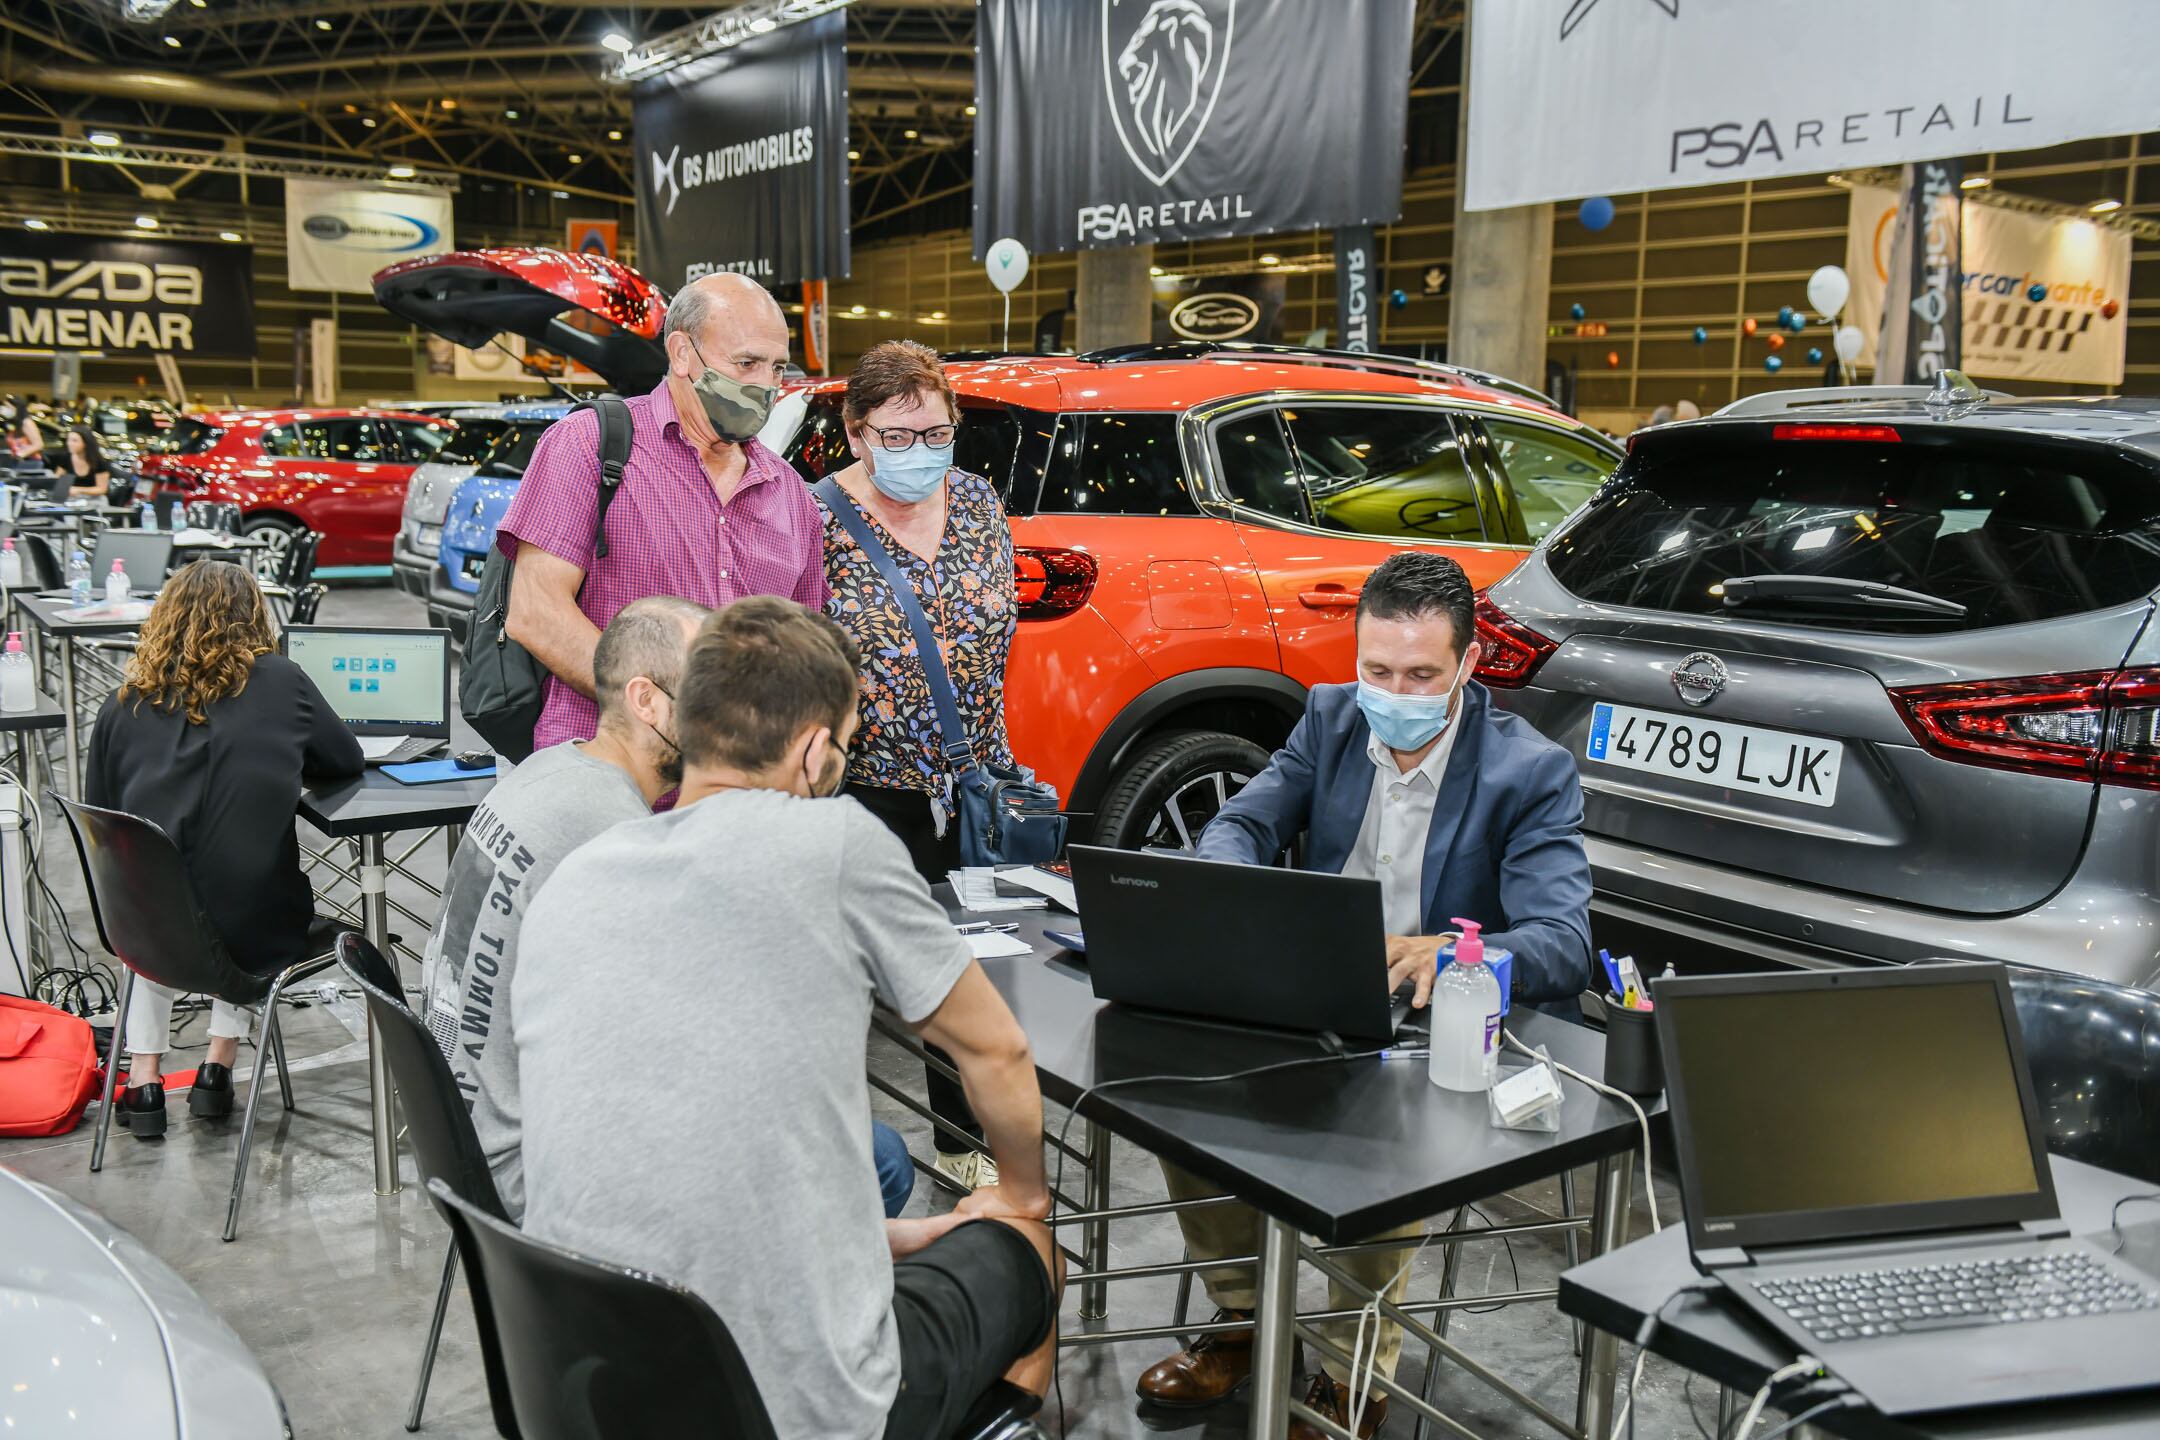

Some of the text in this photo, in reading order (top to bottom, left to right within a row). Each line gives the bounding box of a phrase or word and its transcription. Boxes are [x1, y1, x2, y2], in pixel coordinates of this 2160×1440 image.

[682, 125, 814, 189] DS AUTOMOBILES
[1670, 93, 2033, 174] PSA RETAIL
[1077, 194, 1253, 242] PSA RETAIL
[1594, 737, 1603, 751] E
[1615, 715, 1829, 796] 4789 LJK
[486, 823, 516, 858] 85
[490, 845, 536, 916] NYC
[1110, 873, 1159, 889] Lenovo
[460, 931, 505, 1061] TOMMY
